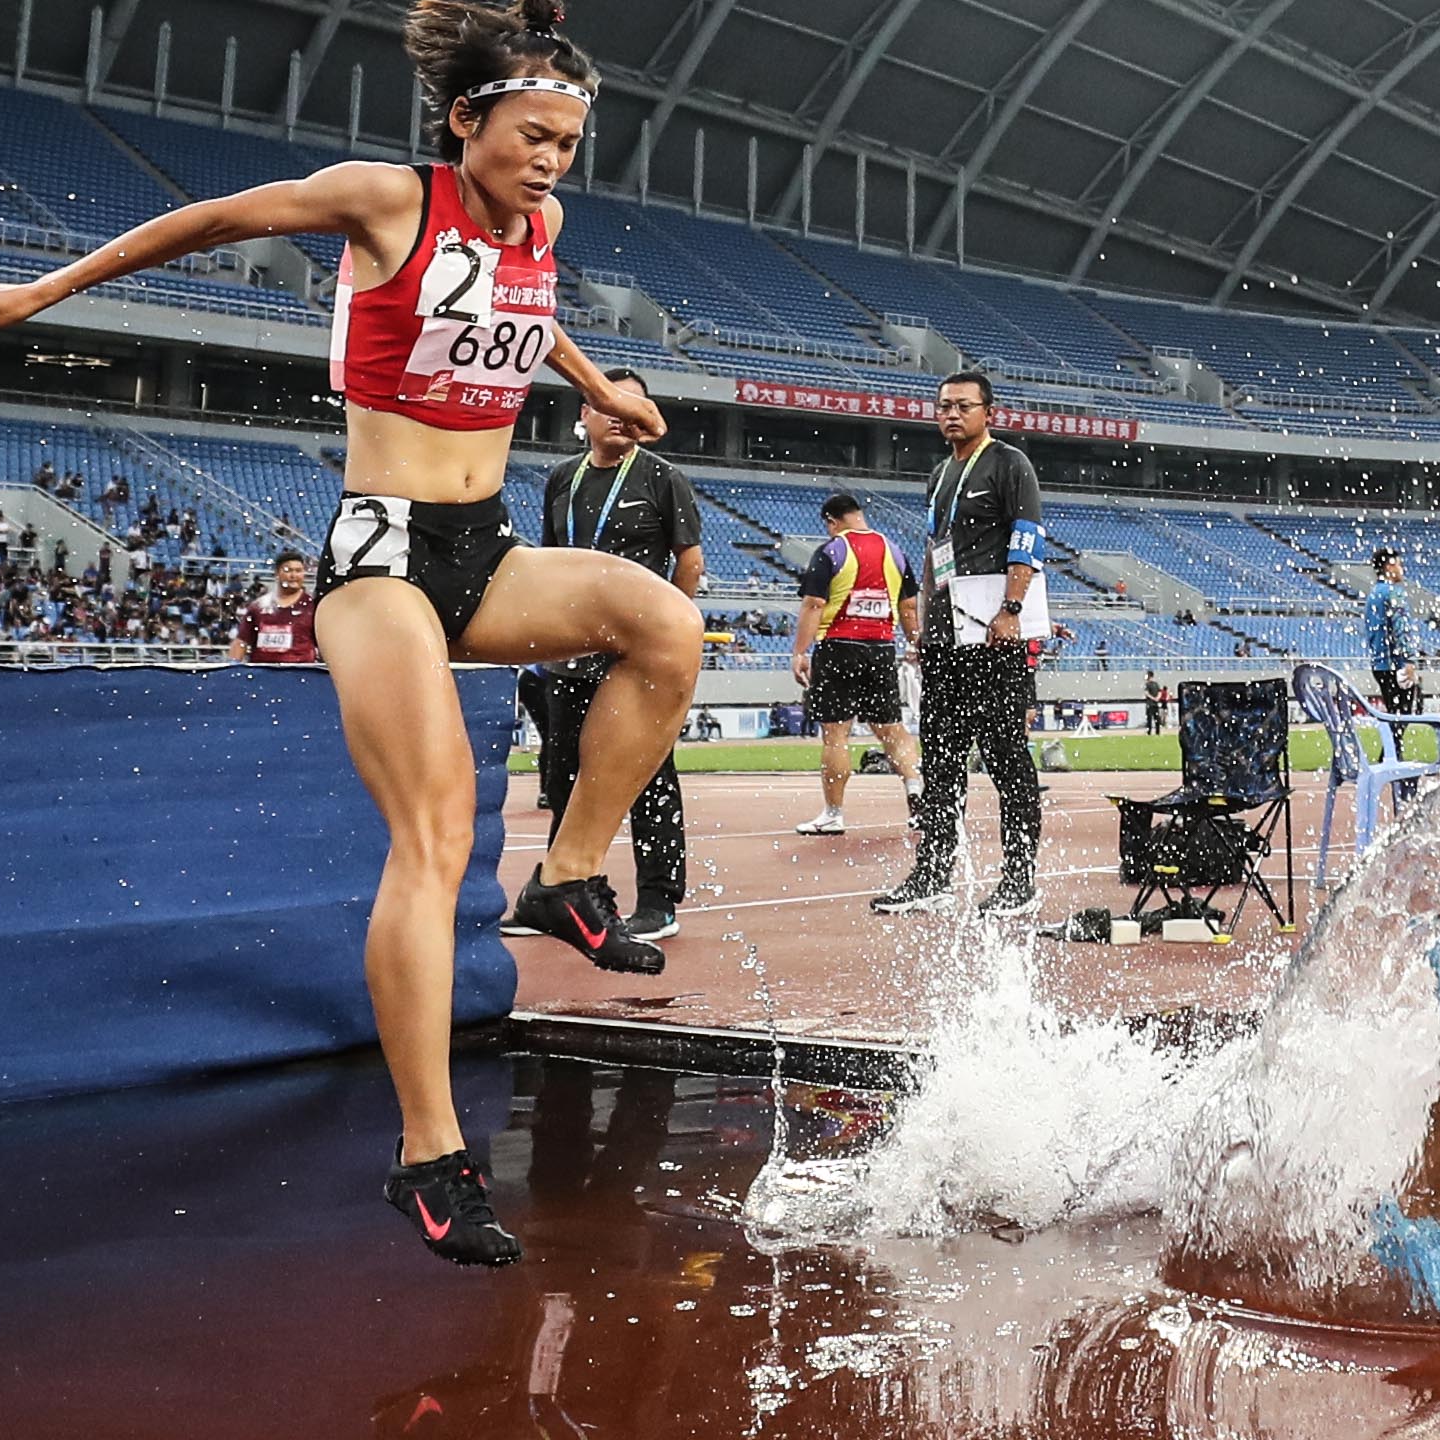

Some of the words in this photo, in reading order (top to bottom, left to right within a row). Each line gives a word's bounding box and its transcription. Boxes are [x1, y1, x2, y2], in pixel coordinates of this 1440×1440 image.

[434, 244, 481, 323] 2
[449, 321, 544, 374] 680
[349, 498, 391, 576] 2
[856, 600, 882, 615] 540
